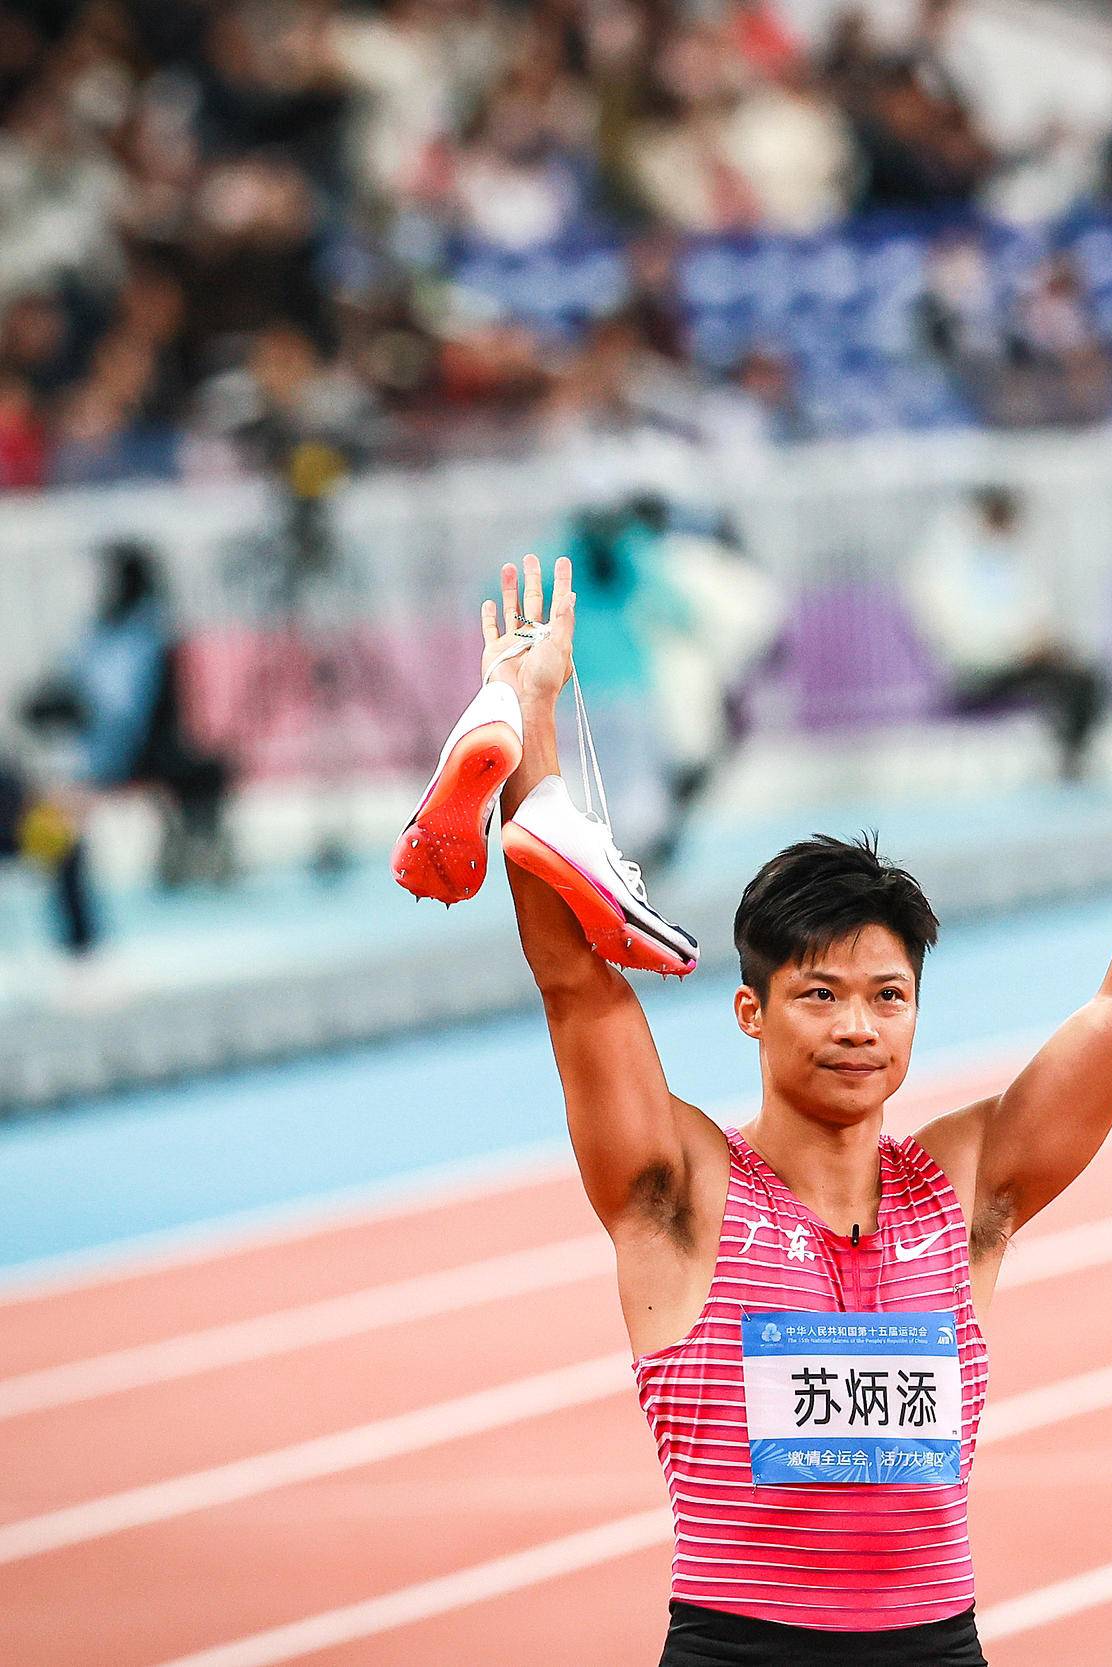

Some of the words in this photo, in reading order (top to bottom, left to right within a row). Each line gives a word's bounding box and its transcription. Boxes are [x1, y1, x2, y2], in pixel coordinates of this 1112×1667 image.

[738, 1213, 816, 1263] 广东
[786, 1326, 927, 1337] 中华人民共和国第十五届运动会
[791, 1366, 938, 1428] 苏炳添
